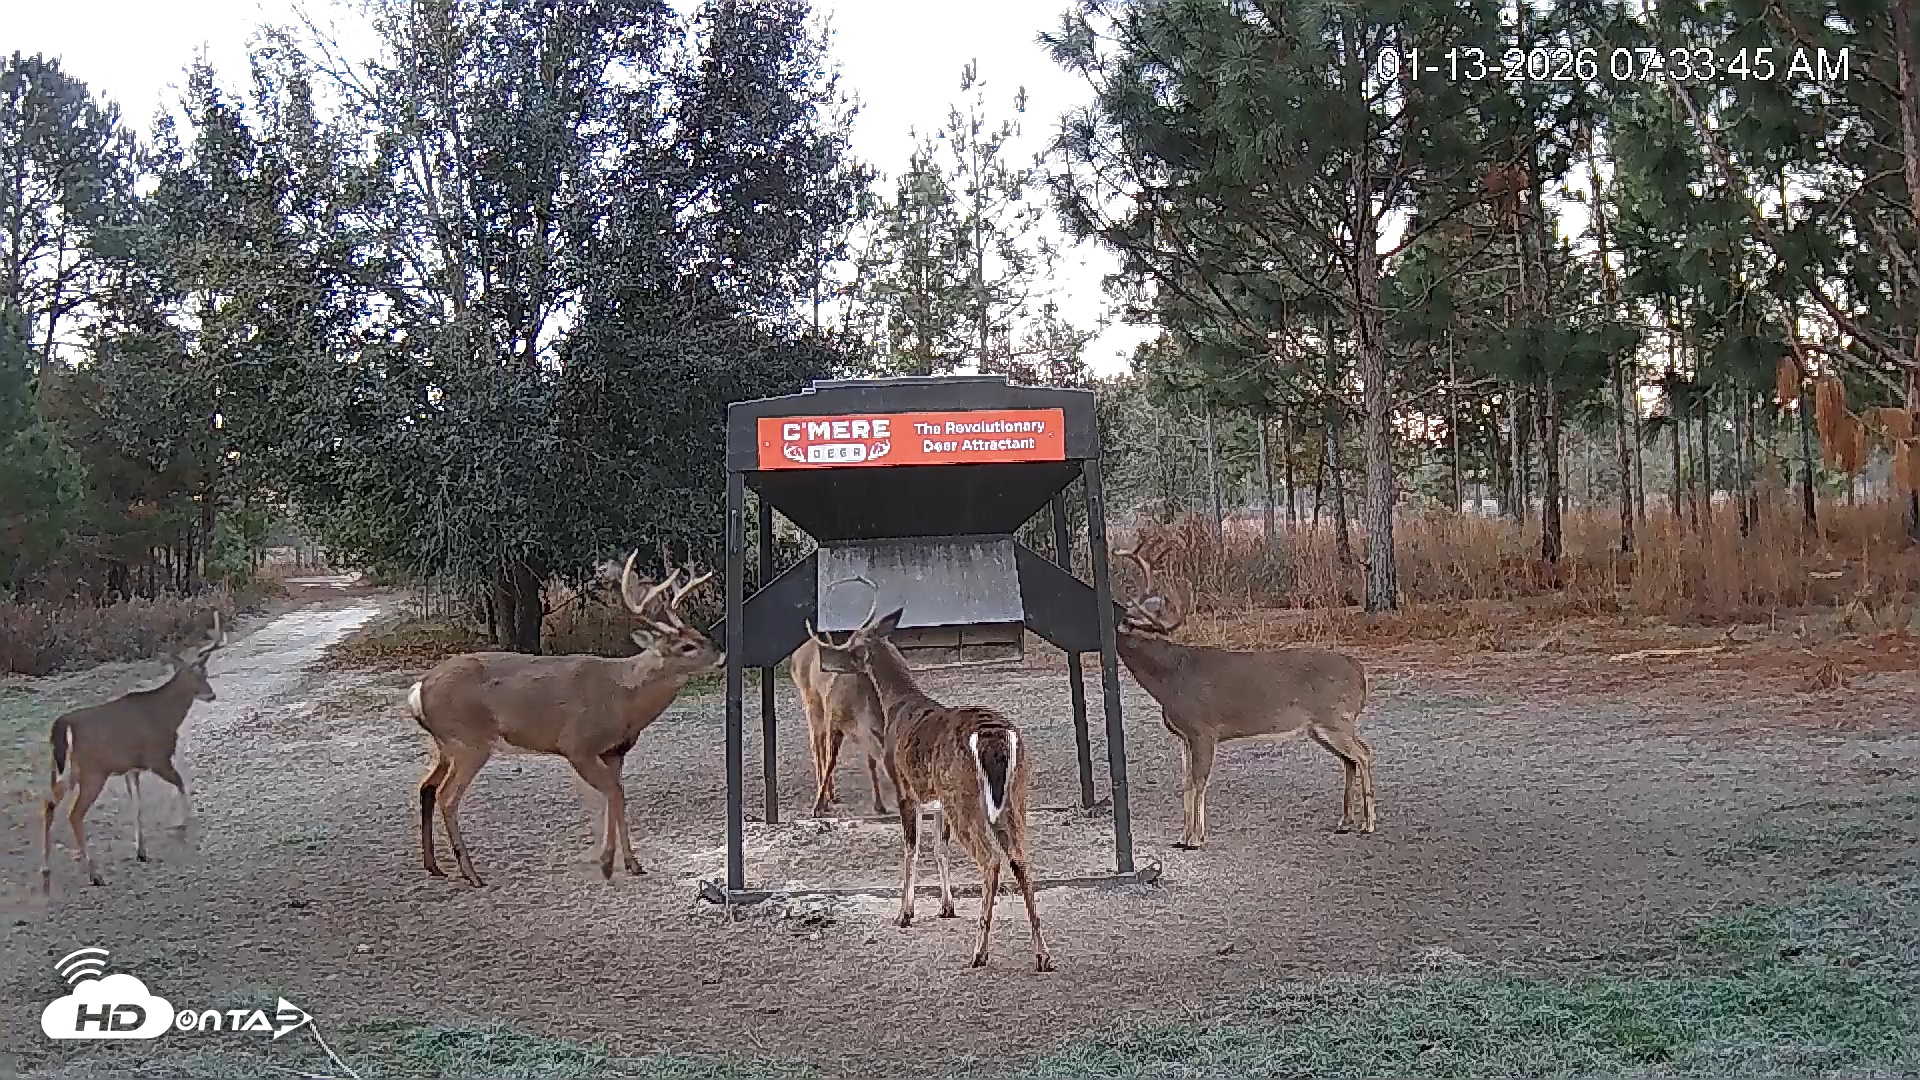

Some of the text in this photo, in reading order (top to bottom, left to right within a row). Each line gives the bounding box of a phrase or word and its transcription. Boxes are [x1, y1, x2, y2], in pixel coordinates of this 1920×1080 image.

[782, 419, 891, 441] C'MERE
[914, 421, 1045, 435] The Revolutionary
[923, 437, 1035, 452] Deer Attractant
